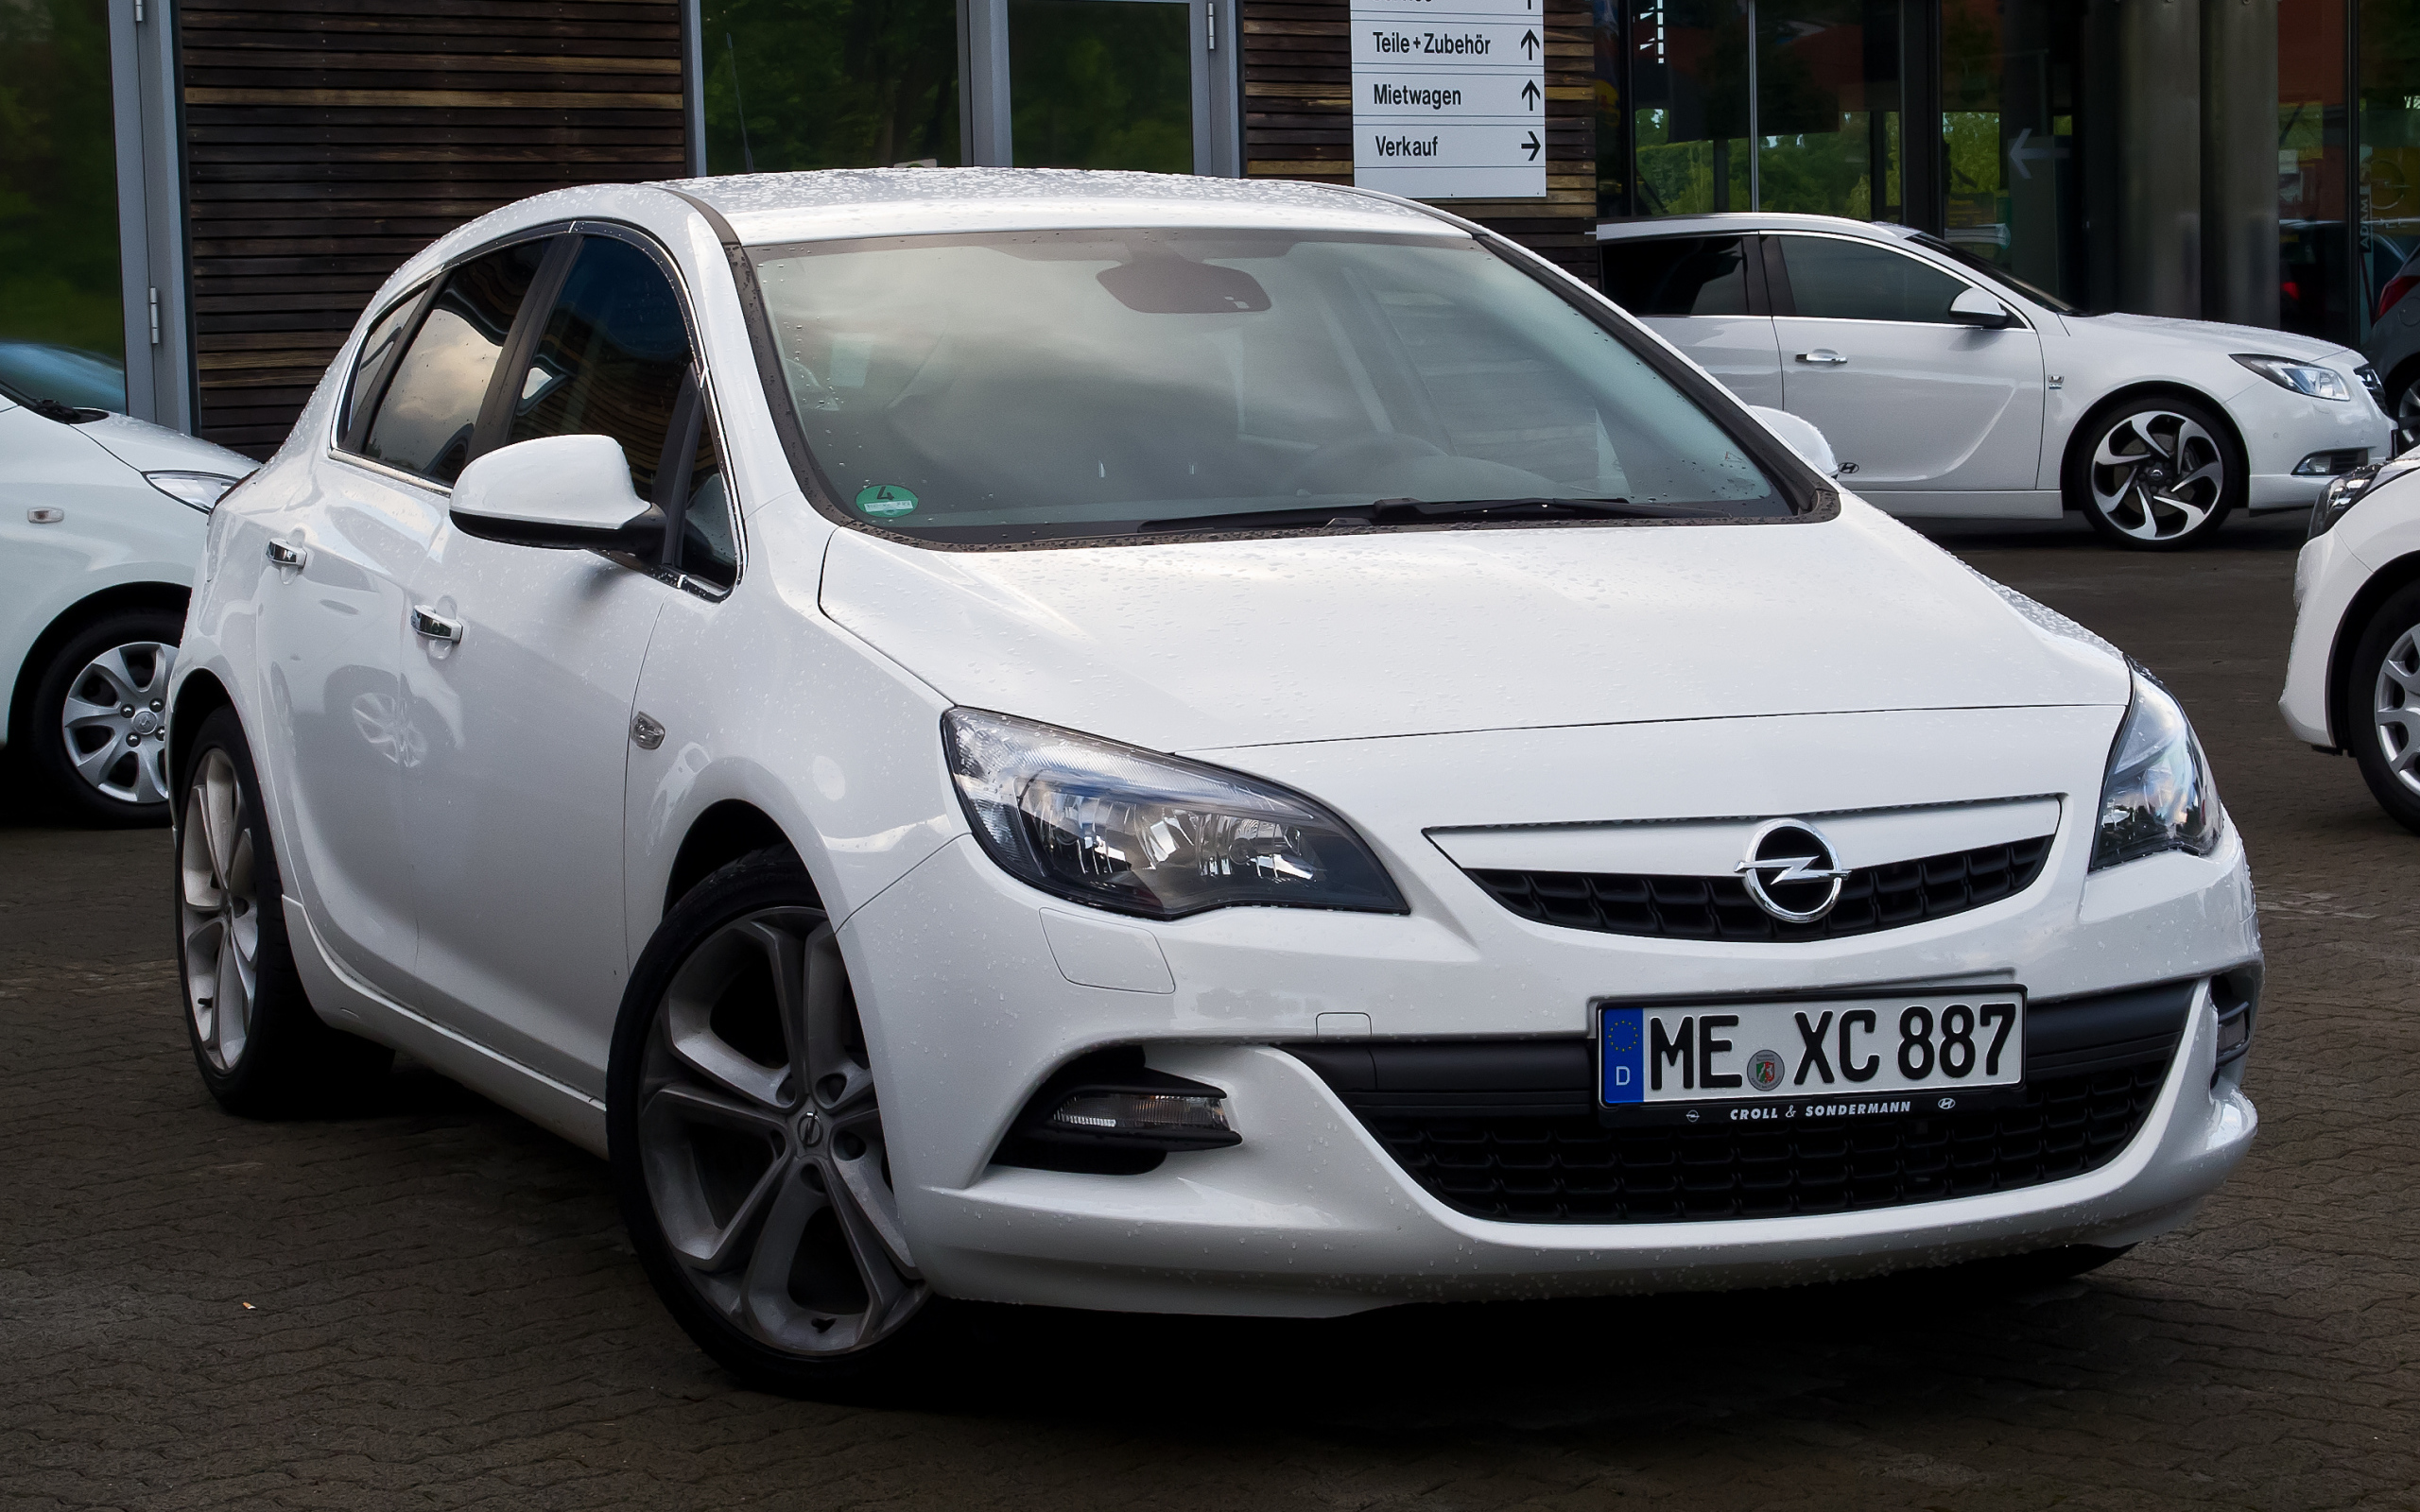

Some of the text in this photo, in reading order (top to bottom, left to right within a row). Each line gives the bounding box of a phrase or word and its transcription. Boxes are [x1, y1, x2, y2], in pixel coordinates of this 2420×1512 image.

[1374, 83, 1461, 110] Mietwagen
[1375, 135, 1438, 157] Verkauf
[877, 486, 895, 500] 4
[1650, 1003, 2016, 1091] ME XC 887
[1616, 1066, 1631, 1086] D
[1730, 1108, 1778, 1121] CROLL
[1805, 1101, 1910, 1117] SONDERMANN
